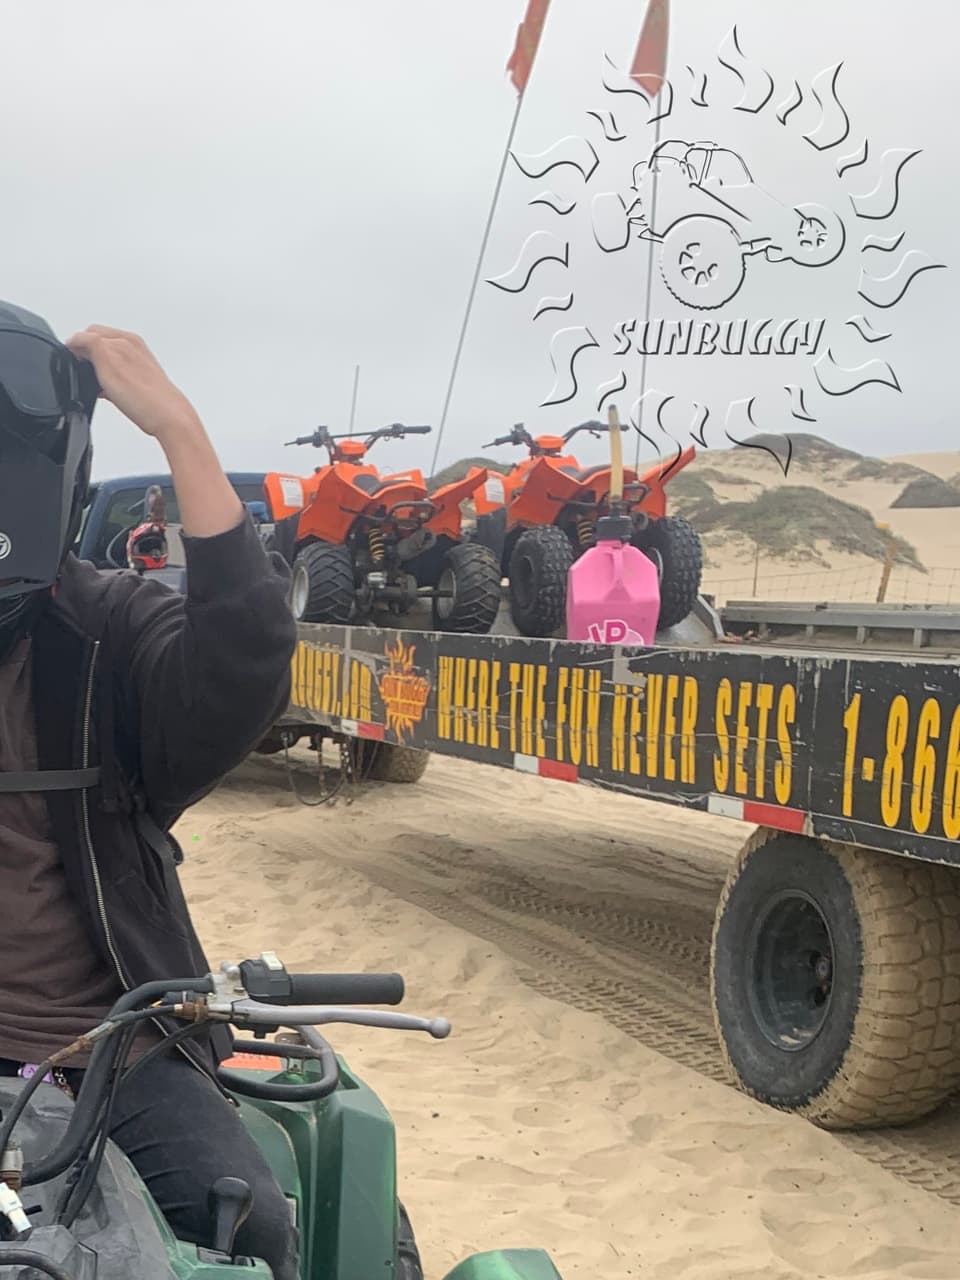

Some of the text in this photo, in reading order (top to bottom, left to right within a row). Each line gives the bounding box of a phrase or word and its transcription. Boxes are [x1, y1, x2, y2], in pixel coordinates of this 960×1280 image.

[438, 656, 501, 749] WHERE
[509, 662, 547, 758] THE
[557, 667, 601, 767] FUN
[612, 672, 698, 784] NEVER
[714, 678, 796, 805] SETS
